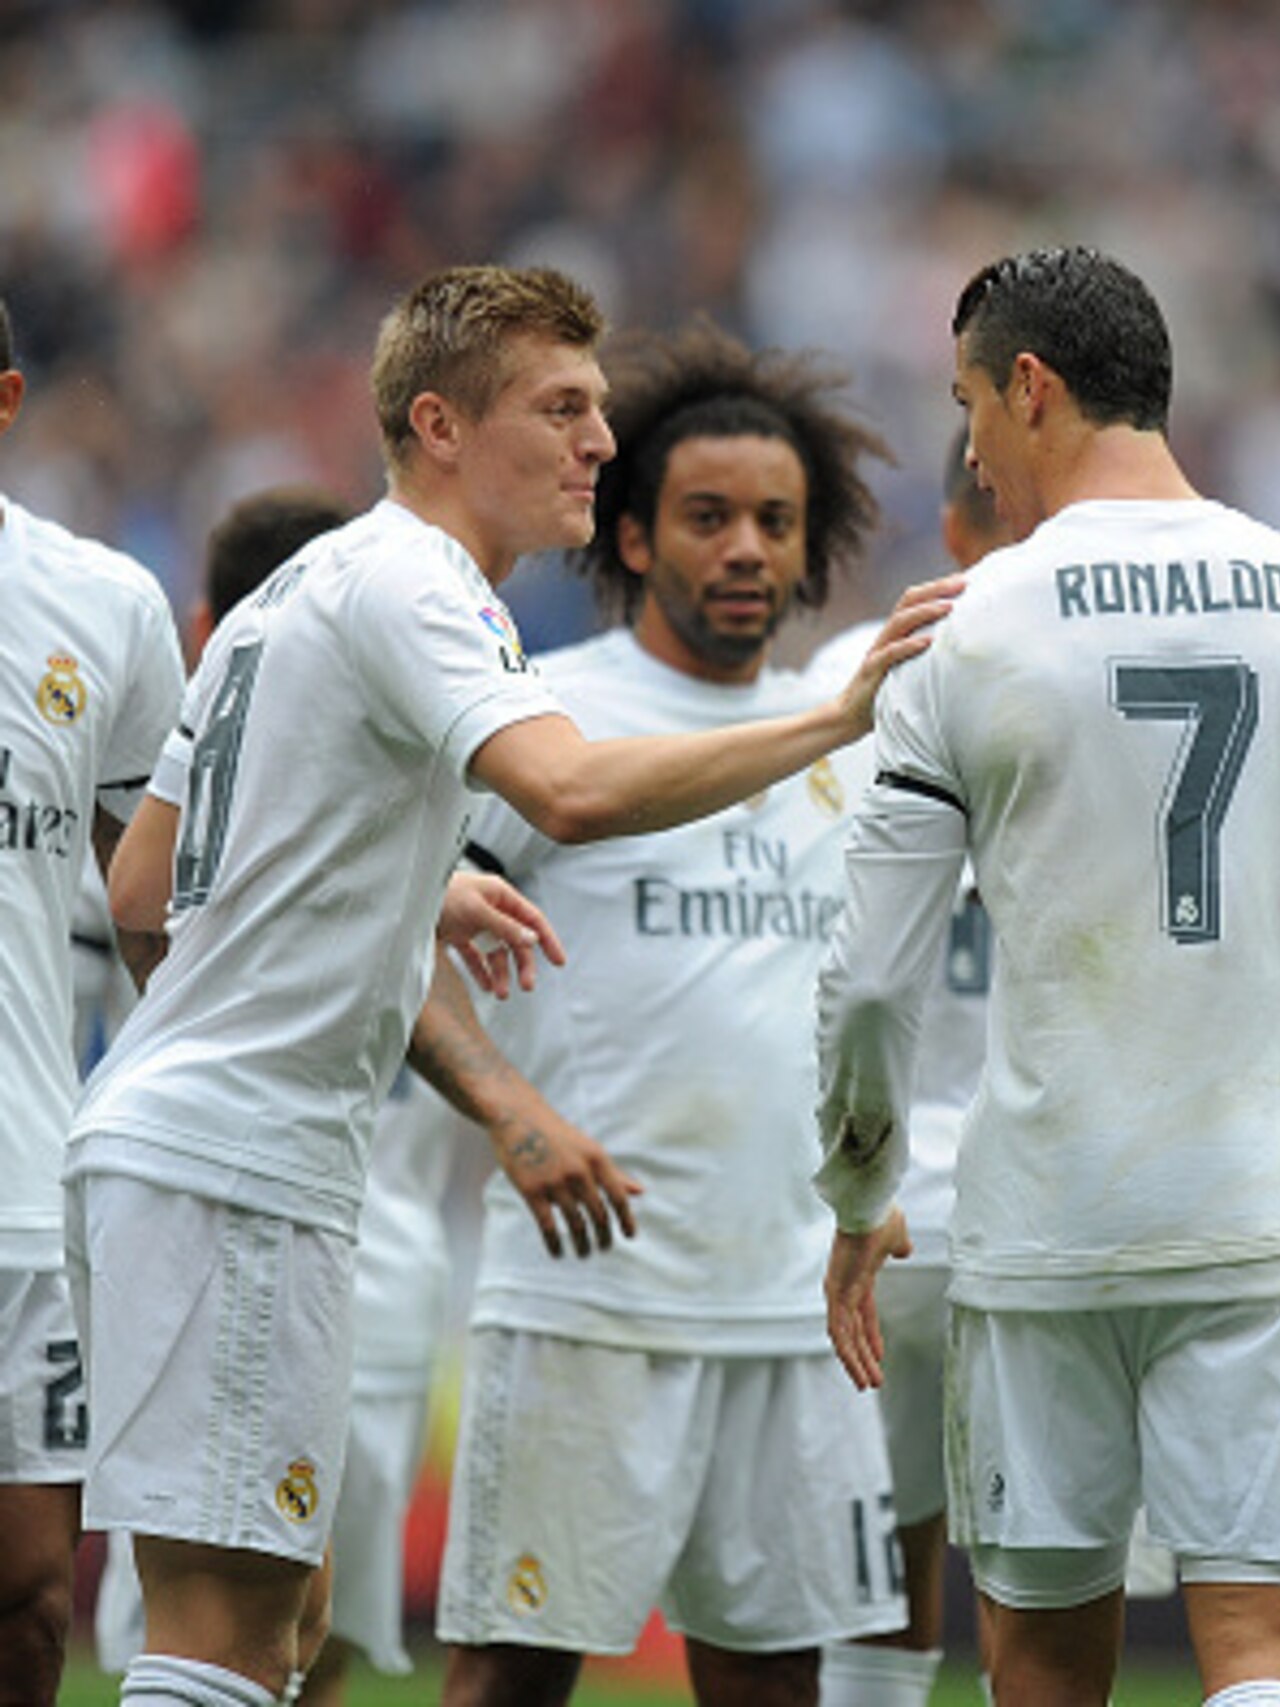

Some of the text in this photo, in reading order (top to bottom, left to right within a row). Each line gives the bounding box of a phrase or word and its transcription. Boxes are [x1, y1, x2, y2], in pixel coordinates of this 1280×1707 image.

[1106, 655, 1260, 944] 7
[724, 831, 788, 879] Fly
[634, 877, 847, 943] Emirate
[44, 1339, 89, 1450] 2
